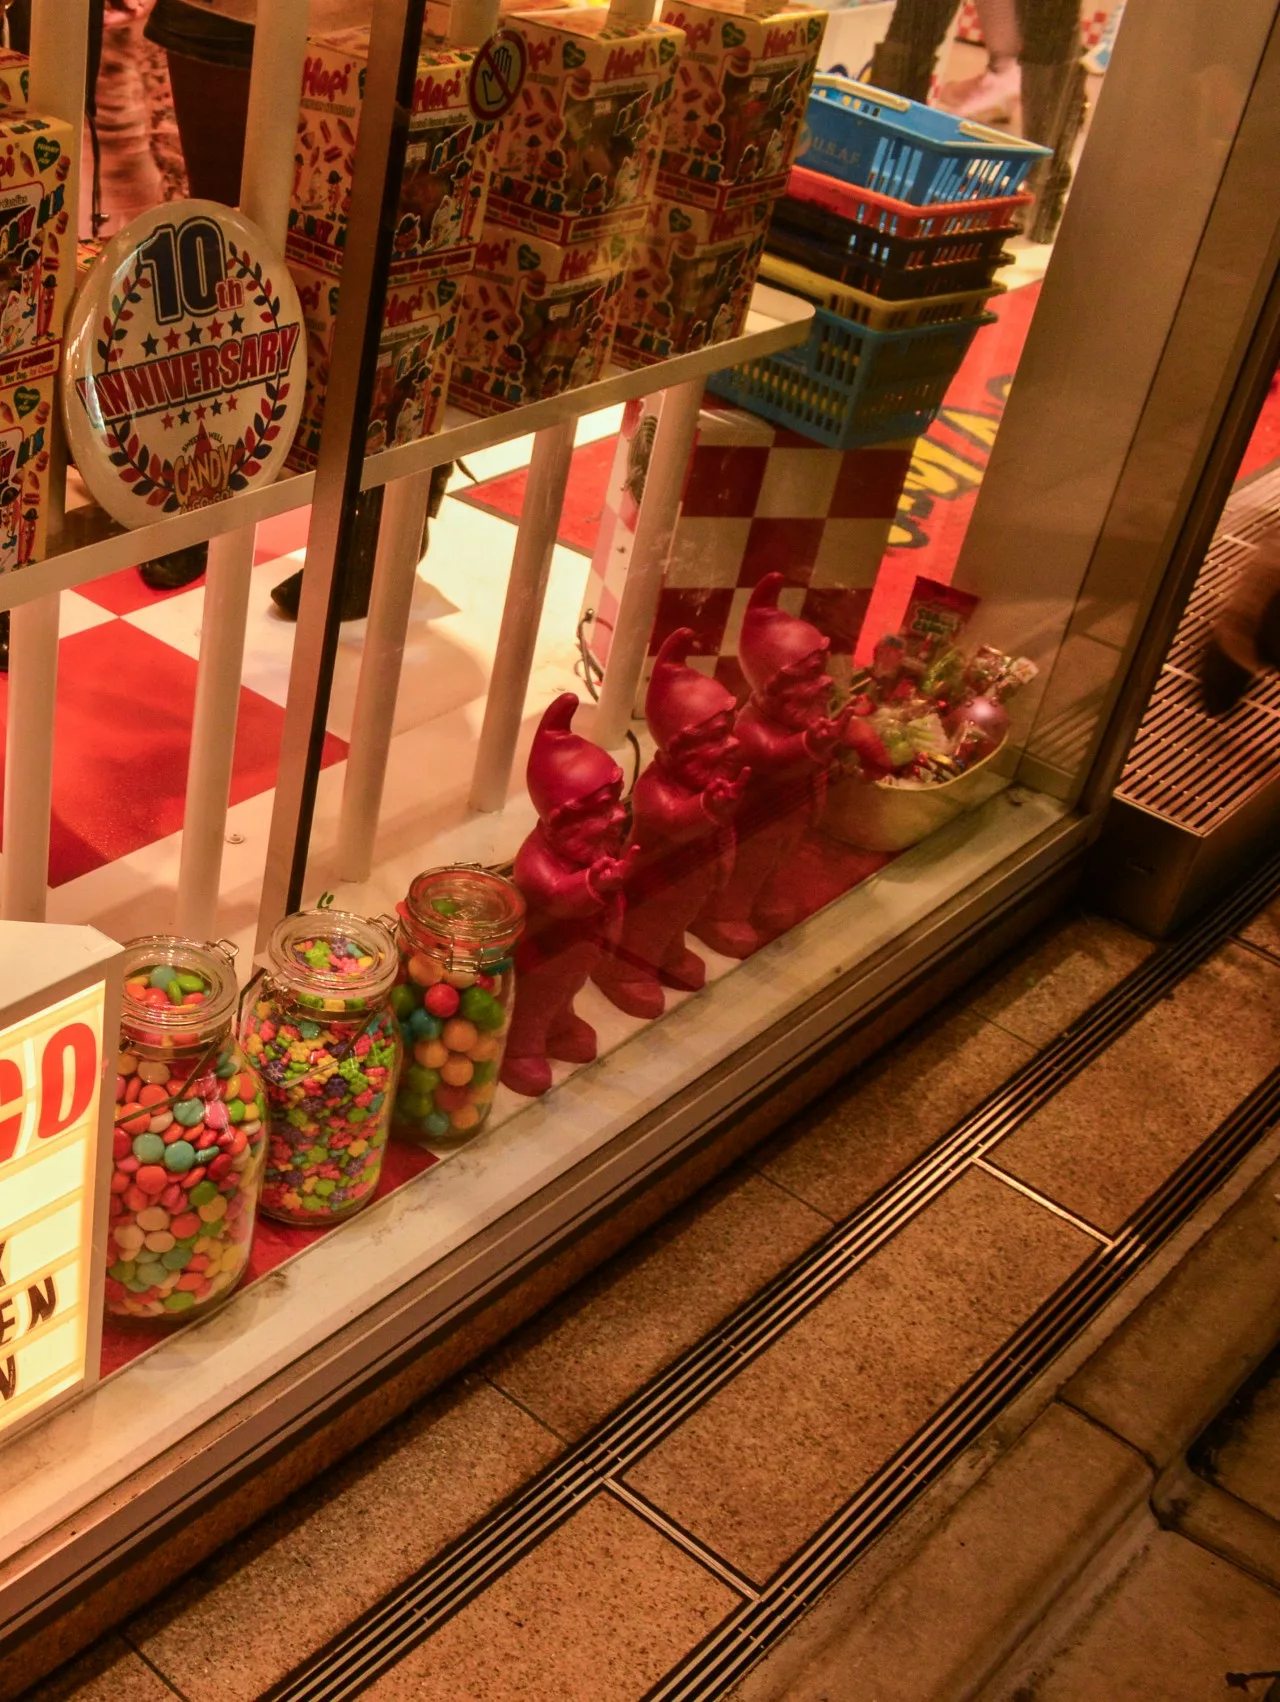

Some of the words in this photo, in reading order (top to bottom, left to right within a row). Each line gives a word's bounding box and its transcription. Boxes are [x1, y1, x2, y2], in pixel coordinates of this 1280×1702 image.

[302, 57, 351, 101] Hapi
[137, 216, 245, 326] 10th
[75, 322, 300, 427] ANNIVERSARY
[174, 444, 235, 506] CANDY
